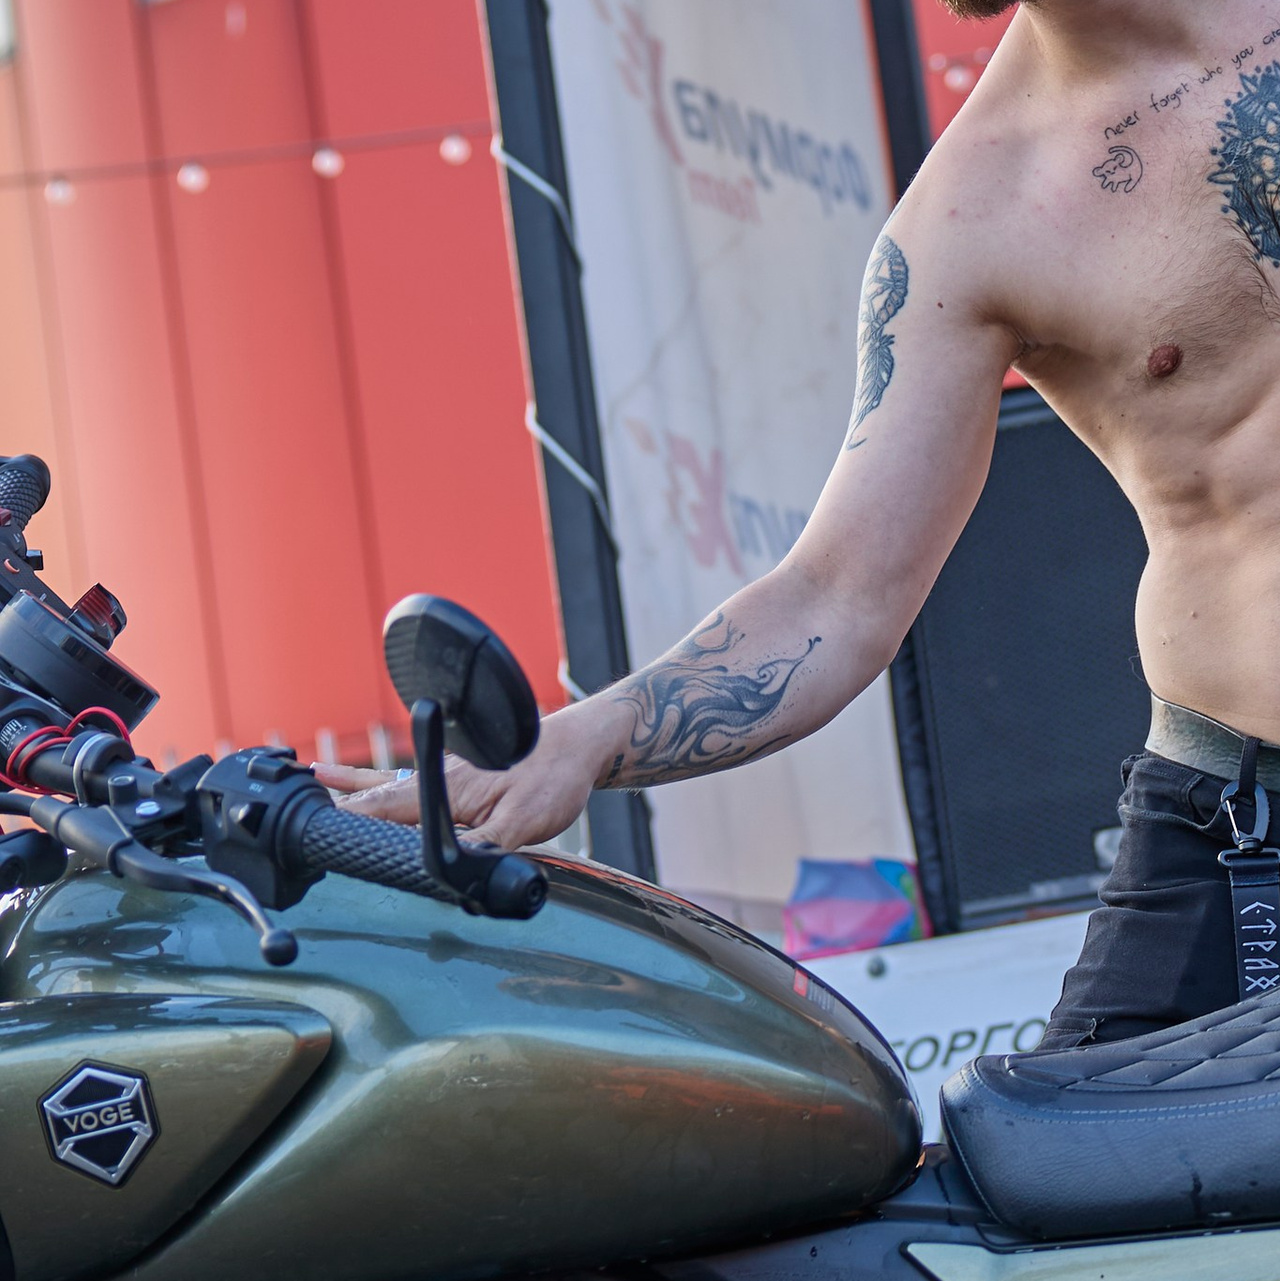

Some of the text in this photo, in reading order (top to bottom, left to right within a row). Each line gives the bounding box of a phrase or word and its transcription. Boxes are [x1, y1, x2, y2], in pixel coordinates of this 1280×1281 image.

[1104, 111, 1141, 140] never
[1149, 83, 1191, 114] forget
[1199, 66, 1224, 85] who
[1231, 45, 1255, 71] you
[891, 1018, 1048, 1073] ОРГО
[63, 1102, 135, 1133] VOGE
